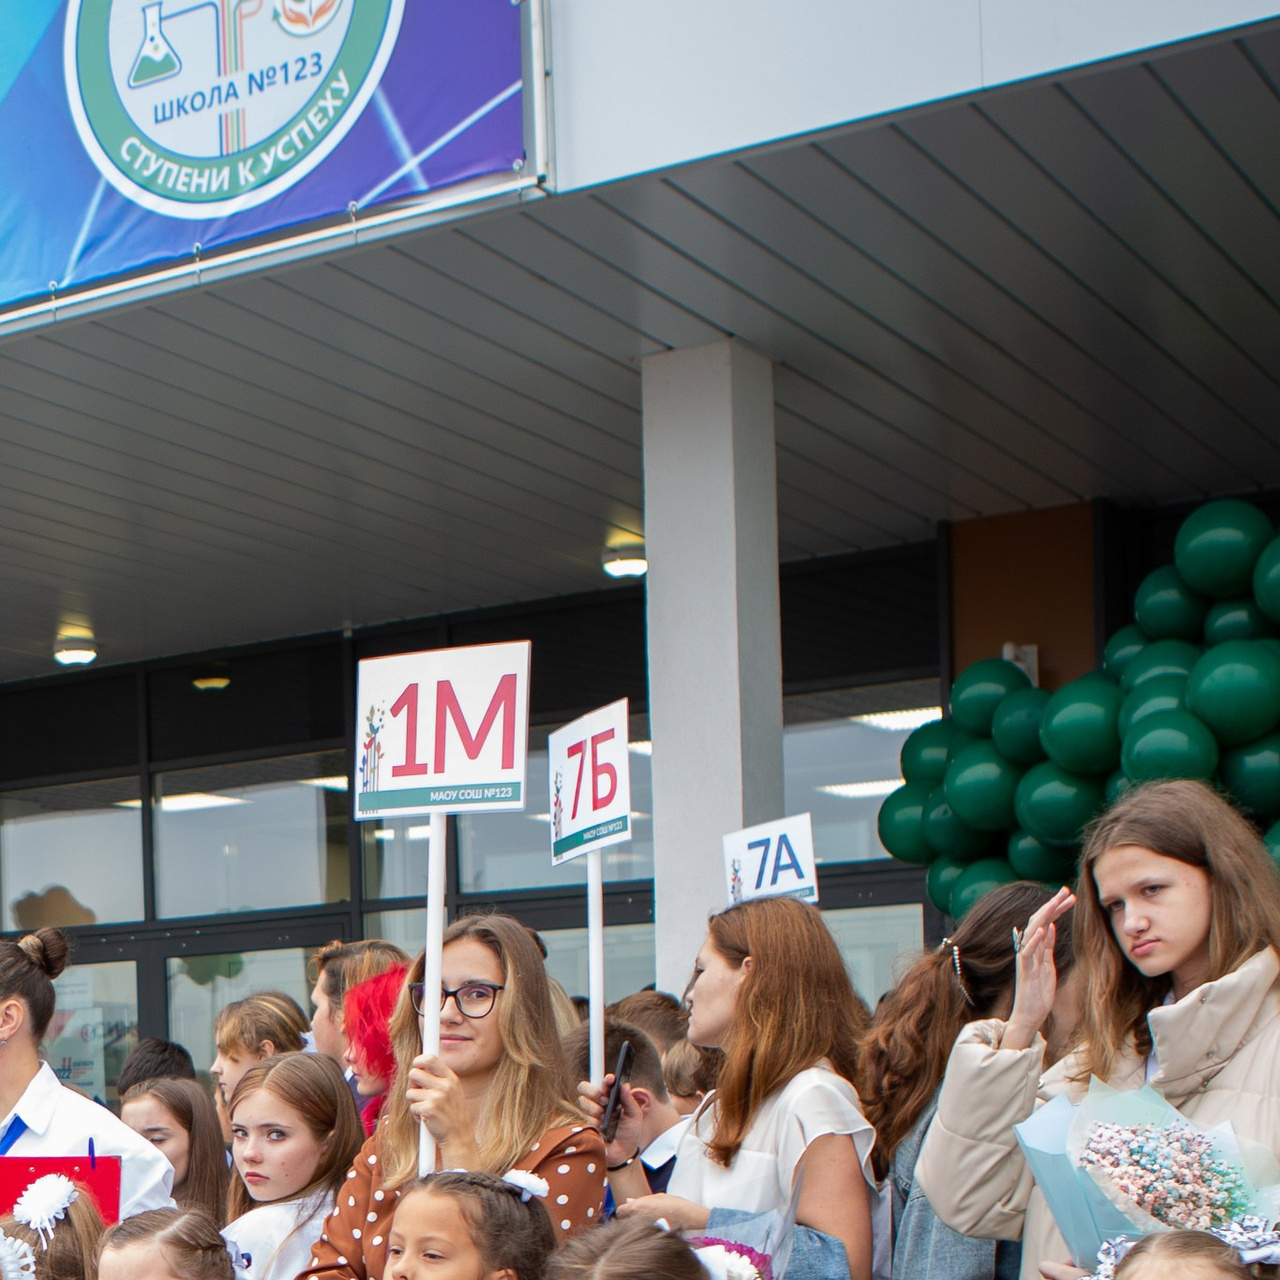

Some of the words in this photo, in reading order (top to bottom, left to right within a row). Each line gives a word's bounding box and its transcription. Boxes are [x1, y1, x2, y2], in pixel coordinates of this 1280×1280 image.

[153, 81, 239, 124] ШКОЛА
[248, 52, 324, 96] №123
[120, 136, 230, 193] СТУПЕНИ
[238, 158, 256, 186] К
[260, 69, 351, 175] УСПЕХУ
[390, 673, 517, 778] 1М
[430, 789, 457, 802] МАОУ
[458, 788, 483, 800] СОШ
[484, 787, 513, 799] №123
[567, 728, 618, 820] 7Б
[747, 833, 805, 890] 7А
